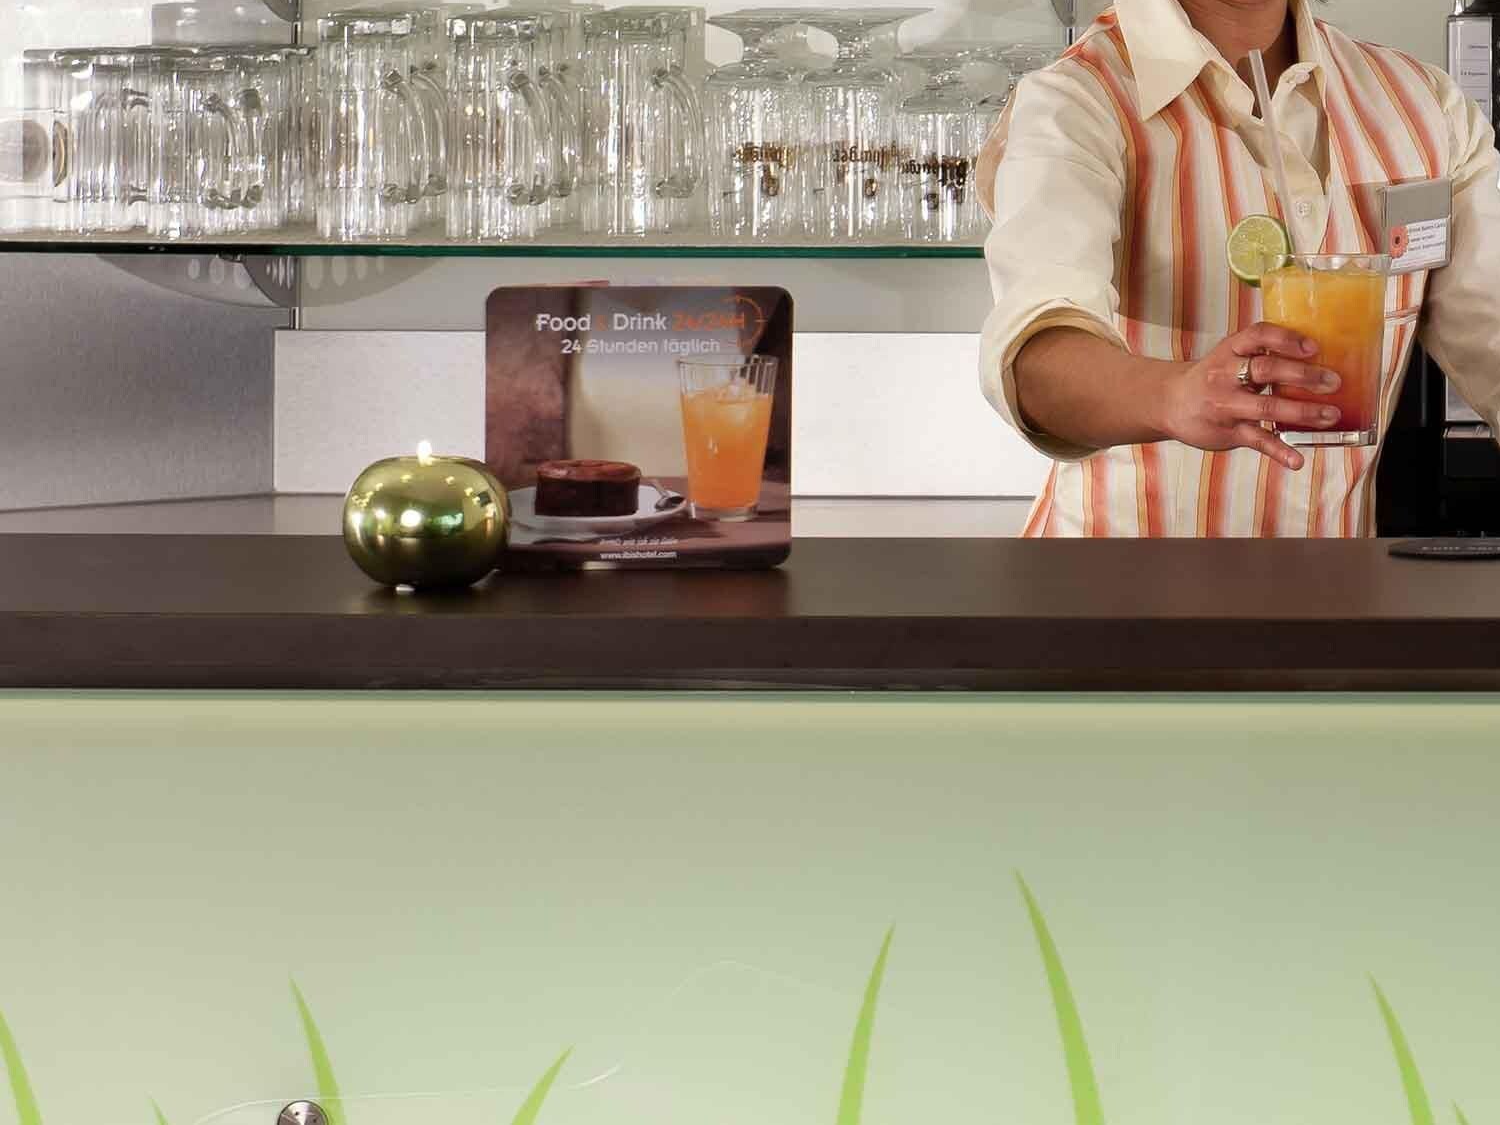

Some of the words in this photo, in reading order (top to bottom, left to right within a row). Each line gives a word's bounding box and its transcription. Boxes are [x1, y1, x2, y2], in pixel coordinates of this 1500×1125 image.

[536, 313, 592, 332] Food
[613, 312, 667, 331] Drink
[561, 338, 582, 355] 24
[587, 338, 659, 355] Stunden
